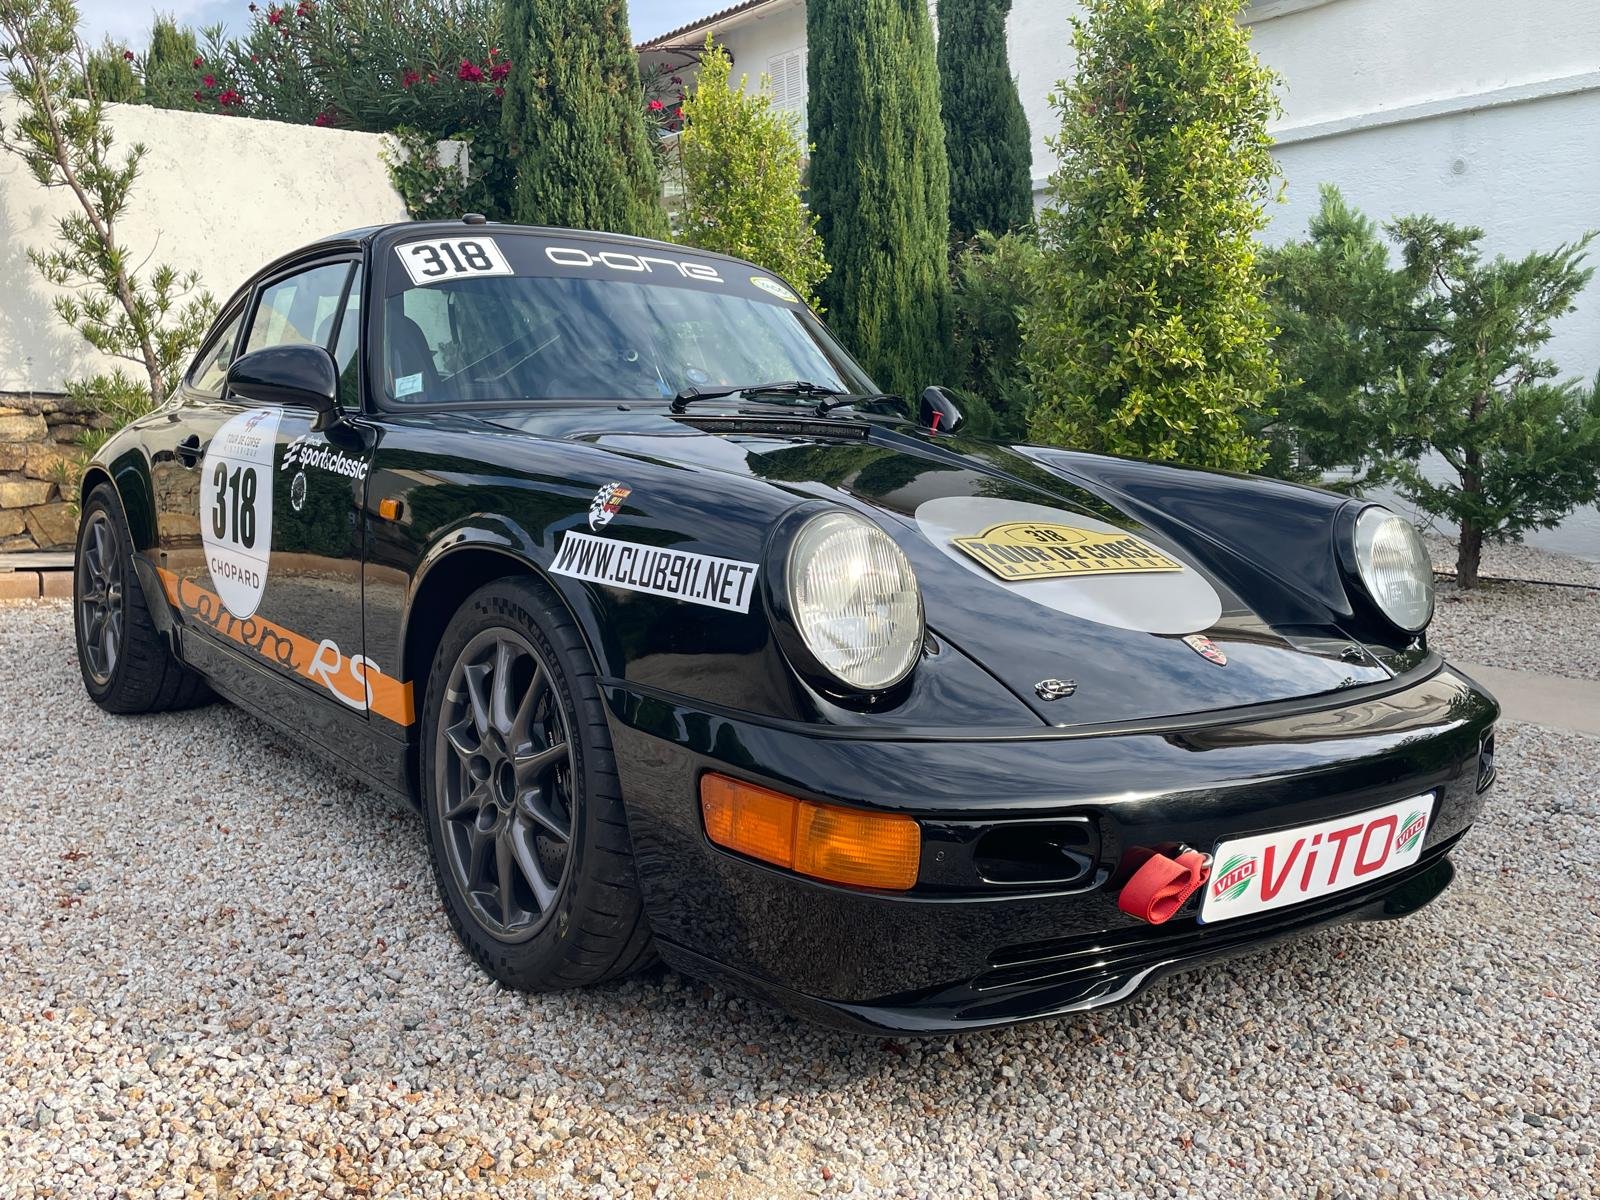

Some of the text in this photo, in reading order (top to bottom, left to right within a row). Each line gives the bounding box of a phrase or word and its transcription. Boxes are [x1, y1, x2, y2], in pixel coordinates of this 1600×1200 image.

[411, 241, 494, 276] 318
[212, 461, 257, 549] 318
[967, 538, 1162, 565] TOUR DE CORSE
[1024, 530, 1068, 542] 318
[211, 558, 260, 589] CHOPARD
[556, 536, 752, 606] WWW.CLUB911.NET
[1003, 558, 1175, 574] HISTORIQUE
[308, 639, 381, 710] RS
